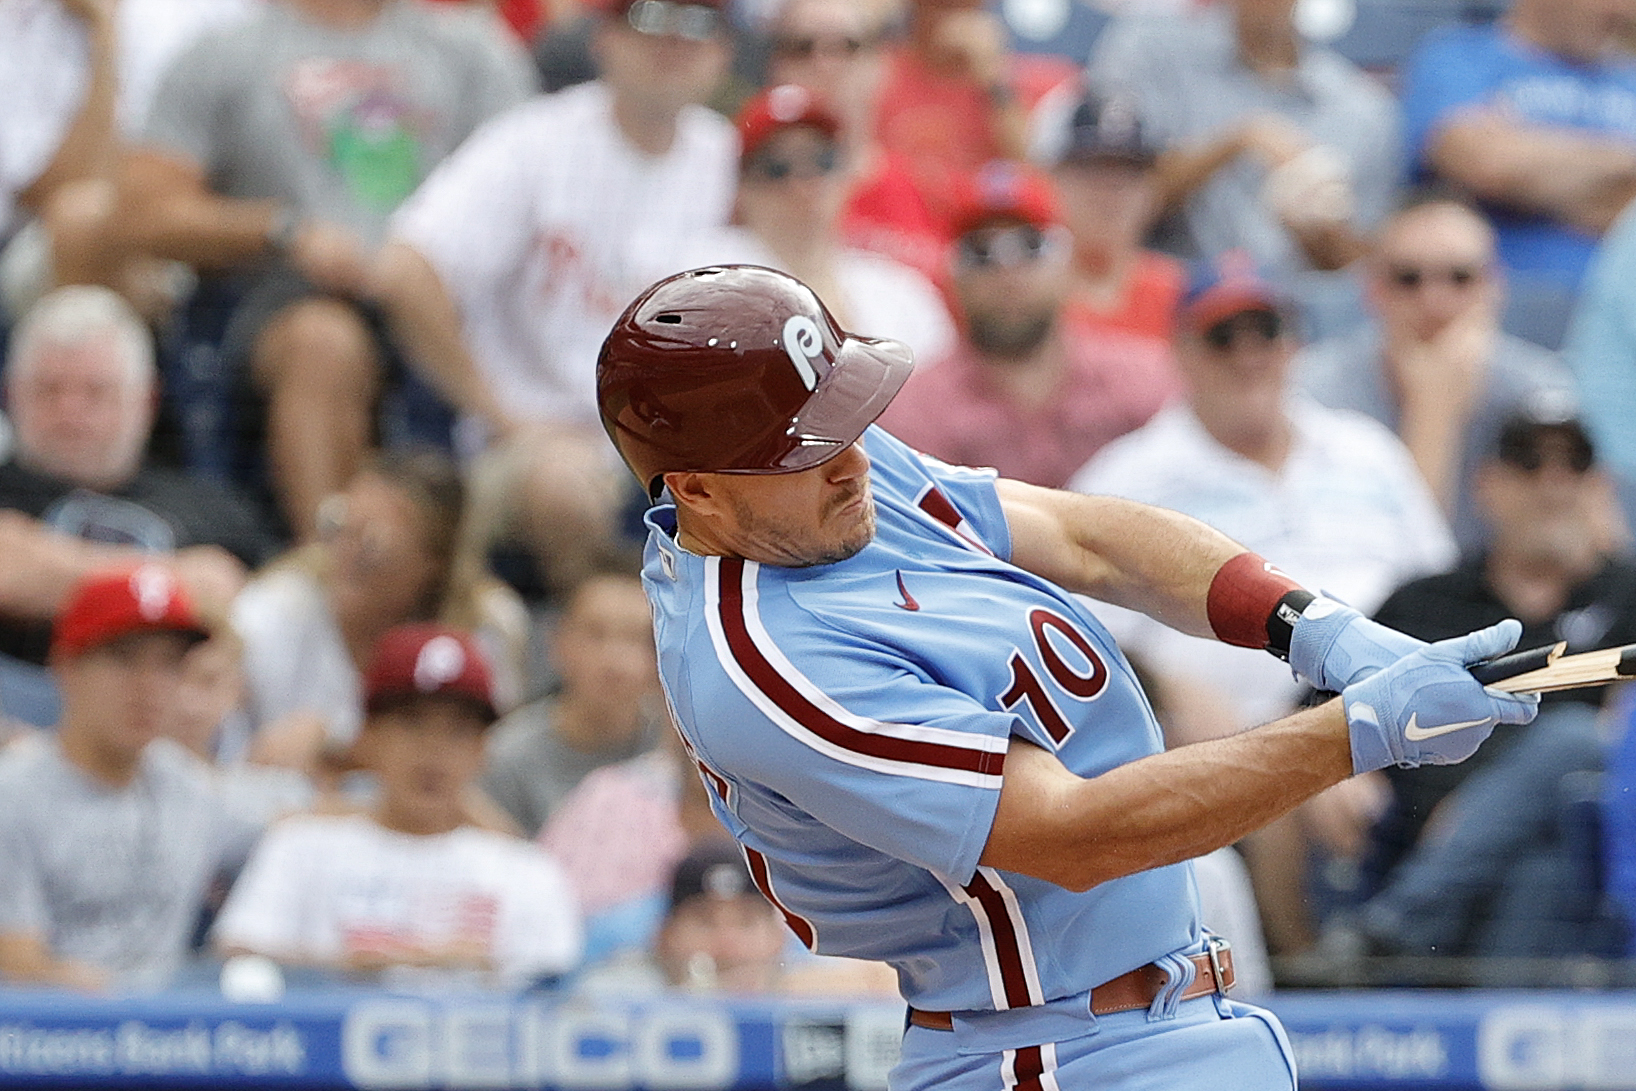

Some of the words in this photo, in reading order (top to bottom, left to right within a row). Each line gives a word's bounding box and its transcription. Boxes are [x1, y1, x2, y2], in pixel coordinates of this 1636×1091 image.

[783, 315, 823, 391] P
[996, 605, 1110, 750] 10
[343, 1004, 740, 1091] GEICO
